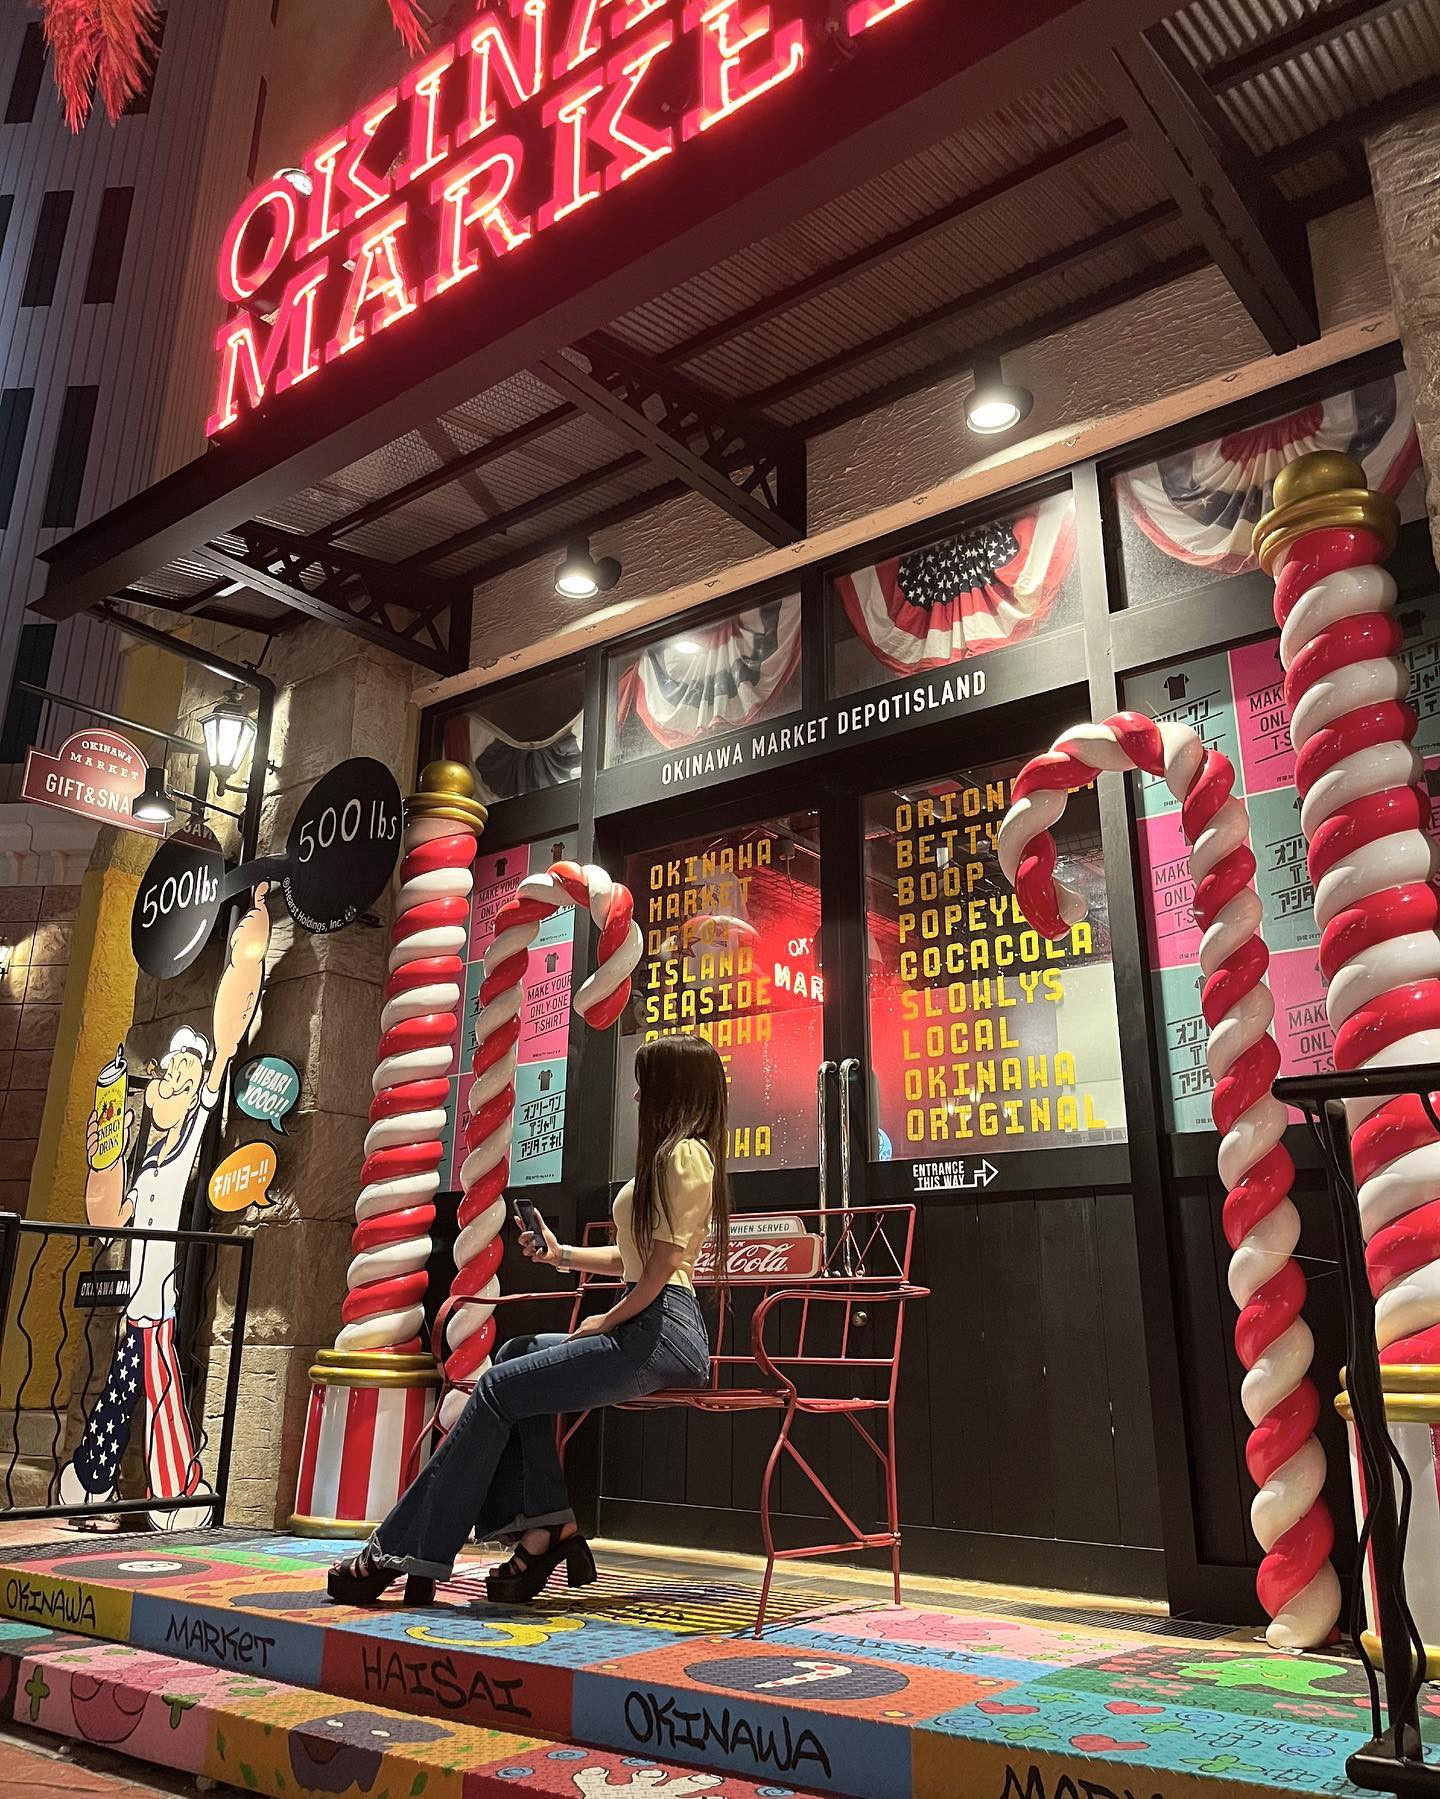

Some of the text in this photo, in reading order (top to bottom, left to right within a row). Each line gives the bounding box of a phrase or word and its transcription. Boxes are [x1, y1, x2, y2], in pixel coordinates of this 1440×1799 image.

[70, 752, 139, 780] MARKET
[82, 741, 132, 763] OKINAWA
[661, 742, 743, 785] OKINAWA
[752, 717, 828, 760] MARKET
[46, 773, 130, 815] GIFT&SNA
[298, 798, 397, 863] 500 lbs
[650, 839, 771, 890] OKINAWA
[897, 862, 984, 906] BOOP
[478, 884, 499, 904] MAKE
[649, 877, 752, 923] MARKET
[297, 911, 328, 933] Holdings,
[330, 919, 344, 930] Inc.
[647, 946, 753, 990] ISLAND
[900, 921, 1092, 981] COCACOLA
[528, 974, 572, 1002] MAKE YOUR
[645, 976, 771, 1024] SEASIDE
[534, 1012, 564, 1034] T-SHIRT
[903, 1017, 1020, 1061] LOCAL
[245, 1062, 293, 1095] CHIBARI
[905, 1051, 1075, 1101] OKINAWA
[242, 1085, 290, 1118] YOOO!!
[906, 1093, 1108, 1142] ORIGINAL
[98, 1119, 121, 1139] ENERGY
[99, 1136, 119, 1156] DRINK
[913, 1160, 965, 1177] ENTRANCE
[917, 1174, 965, 1189] THIS WAY
[730, 1223, 790, 1234] WHEN SERVED
[81, 1282, 114, 1297] OKIAWA
[6, 1579, 96, 1629] OKINAWA
[361, 1646, 532, 1718] HAISAI
[624, 1690, 832, 1778] OKINAWA
